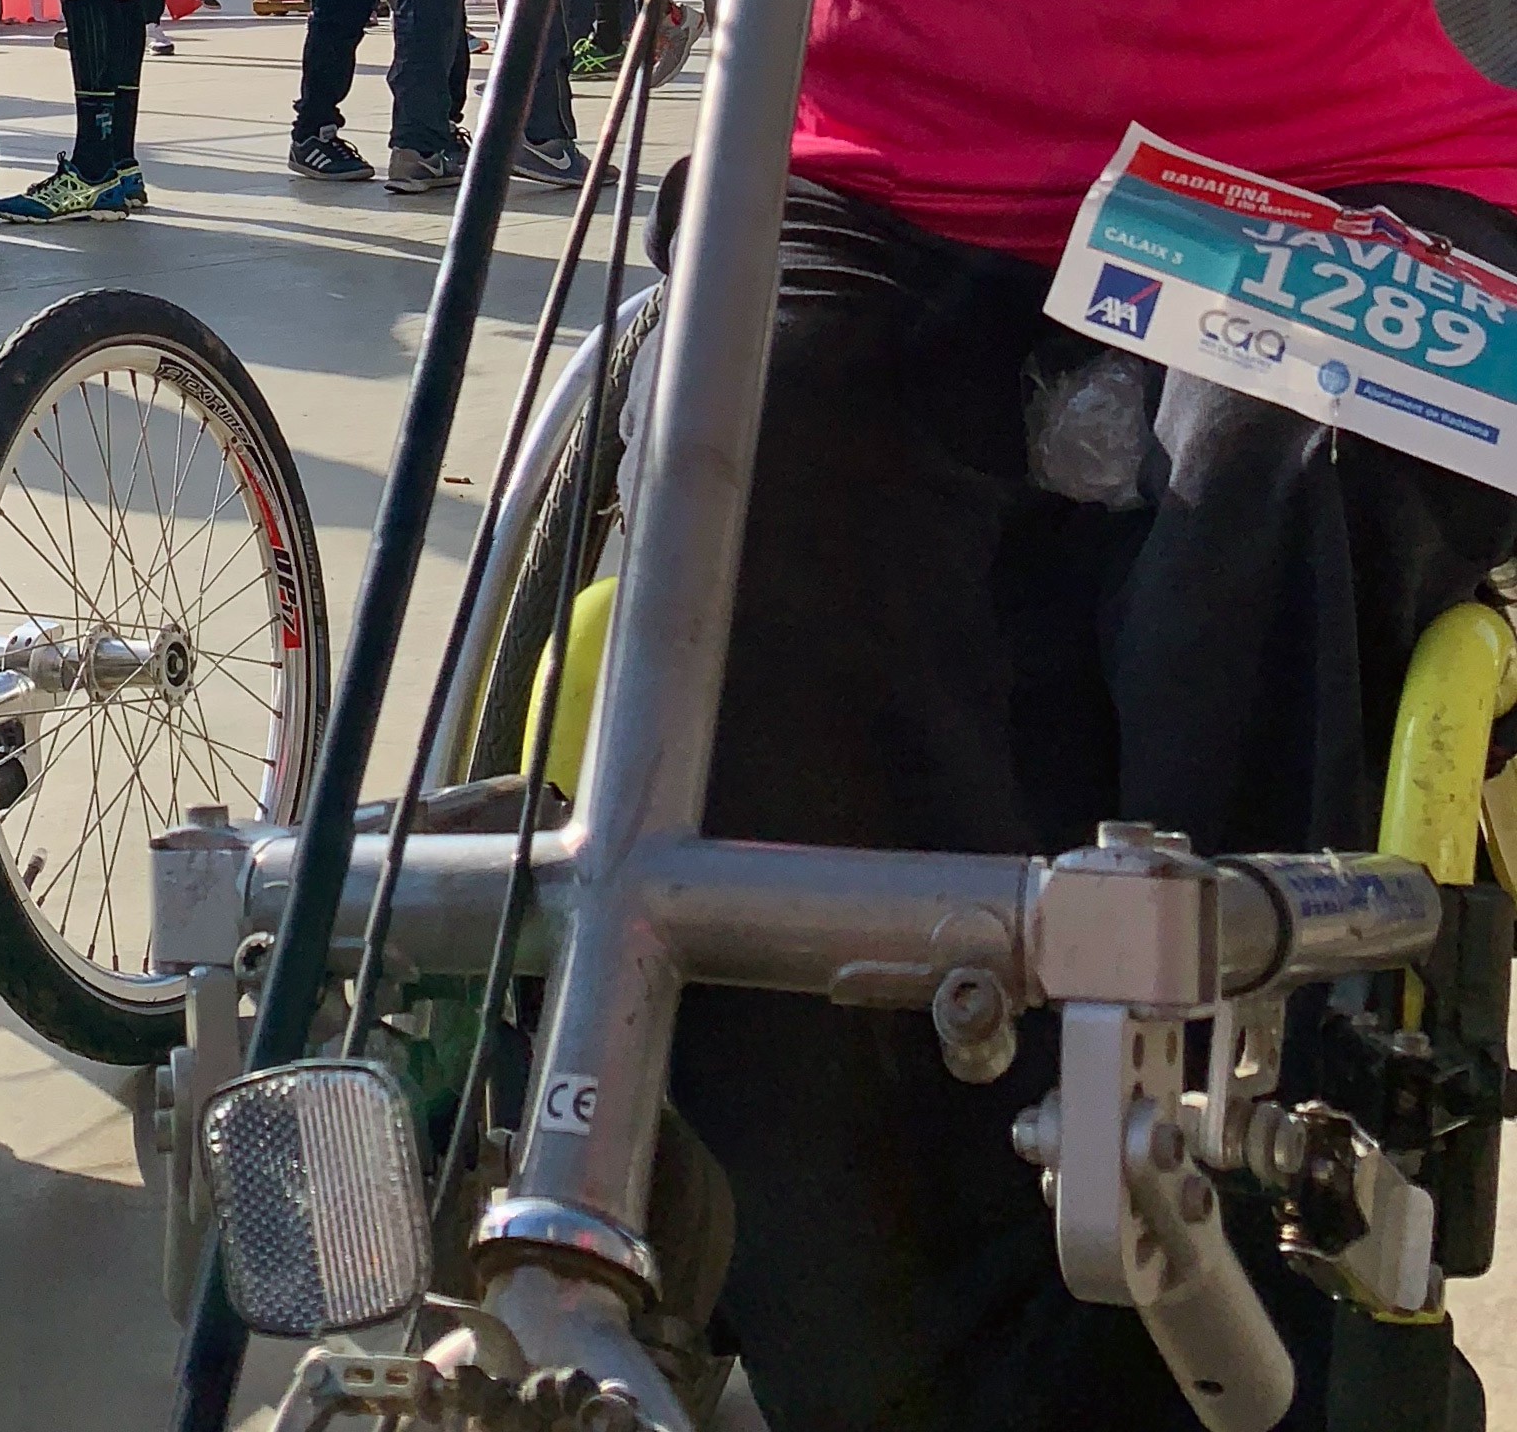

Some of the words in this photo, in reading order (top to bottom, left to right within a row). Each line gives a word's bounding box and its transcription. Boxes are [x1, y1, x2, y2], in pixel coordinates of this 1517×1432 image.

[1161, 169, 1270, 205] BADALONA
[1103, 226, 1170, 260] CALAIX
[1241, 221, 1507, 325] JAVIER
[1085, 295, 1138, 333] AXA
[1240, 243, 1487, 368] 1289
